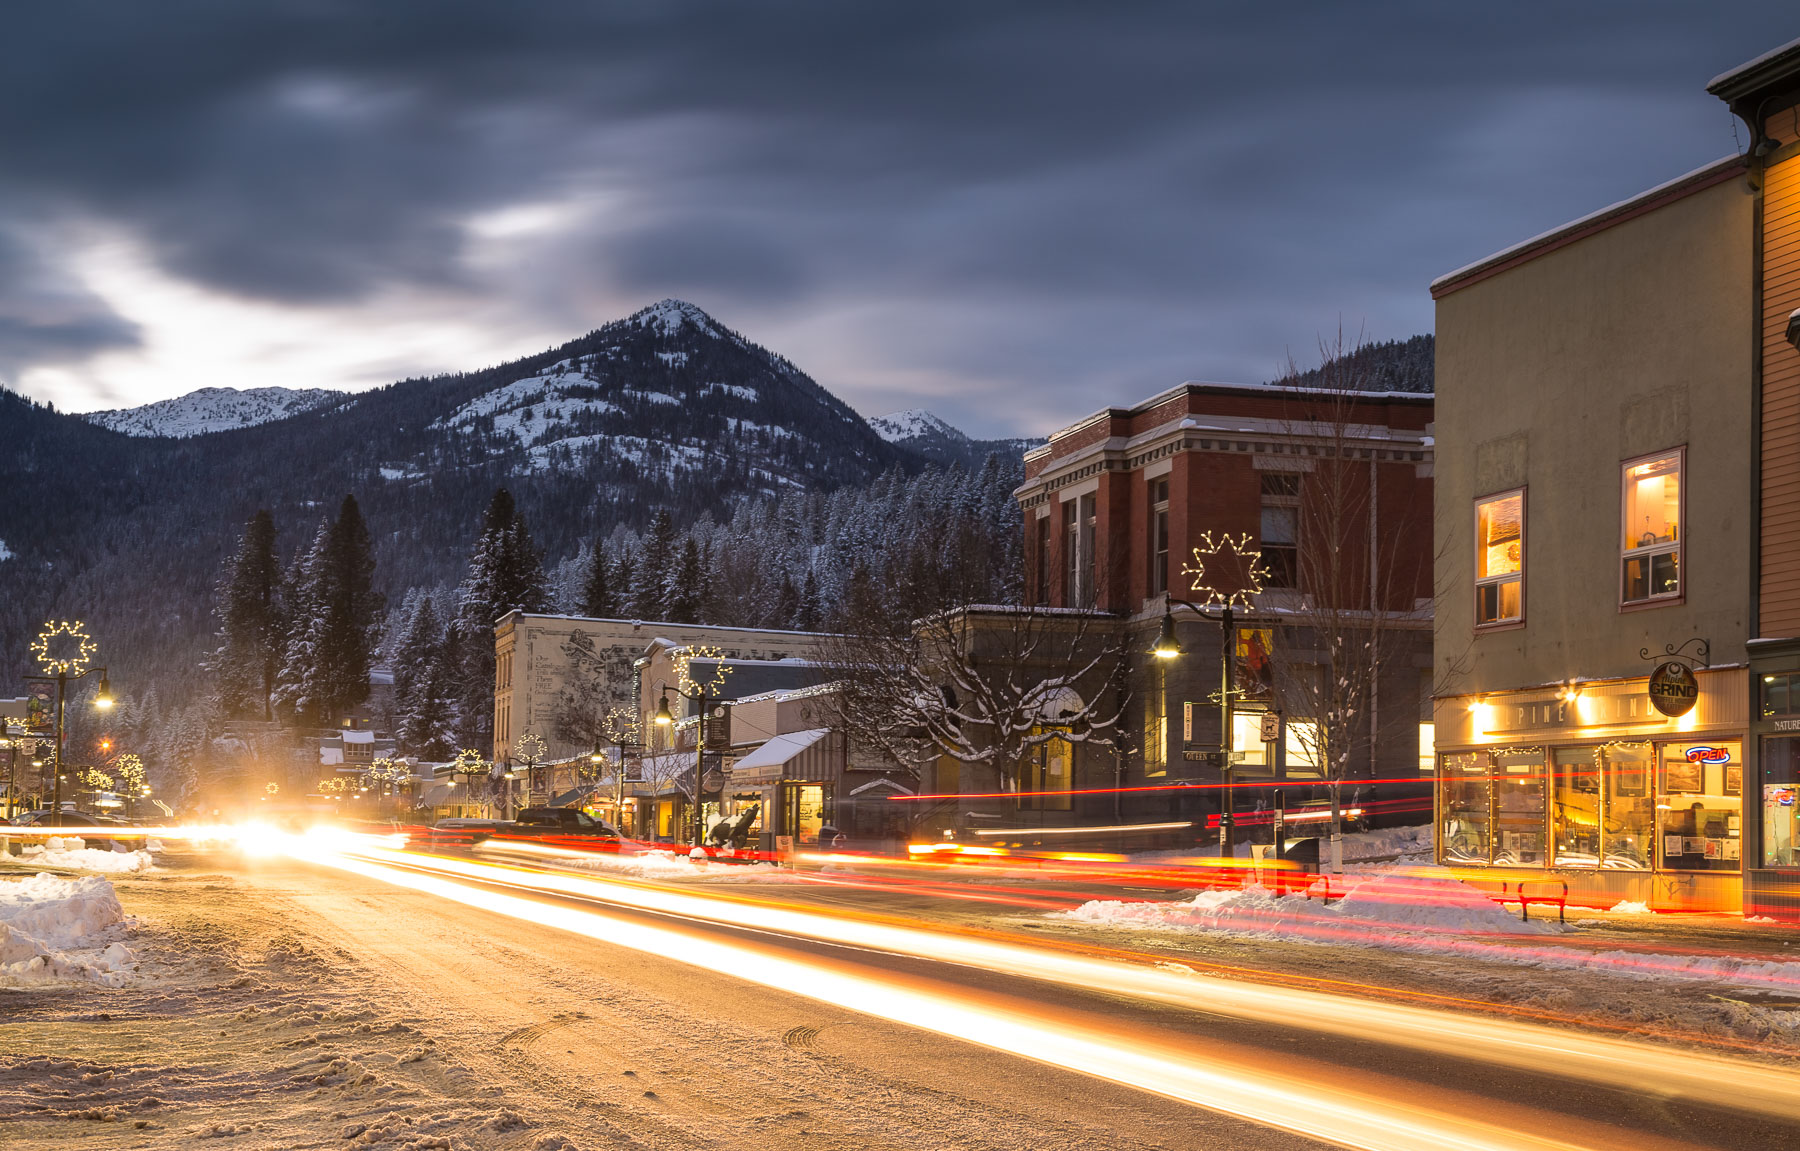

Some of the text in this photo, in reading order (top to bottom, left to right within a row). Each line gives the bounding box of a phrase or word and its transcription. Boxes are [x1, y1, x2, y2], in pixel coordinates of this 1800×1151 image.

[1650, 682, 1698, 697] GRIND
[1186, 752, 1208, 760] QUEEN
[1687, 748, 1728, 763] OPEN
